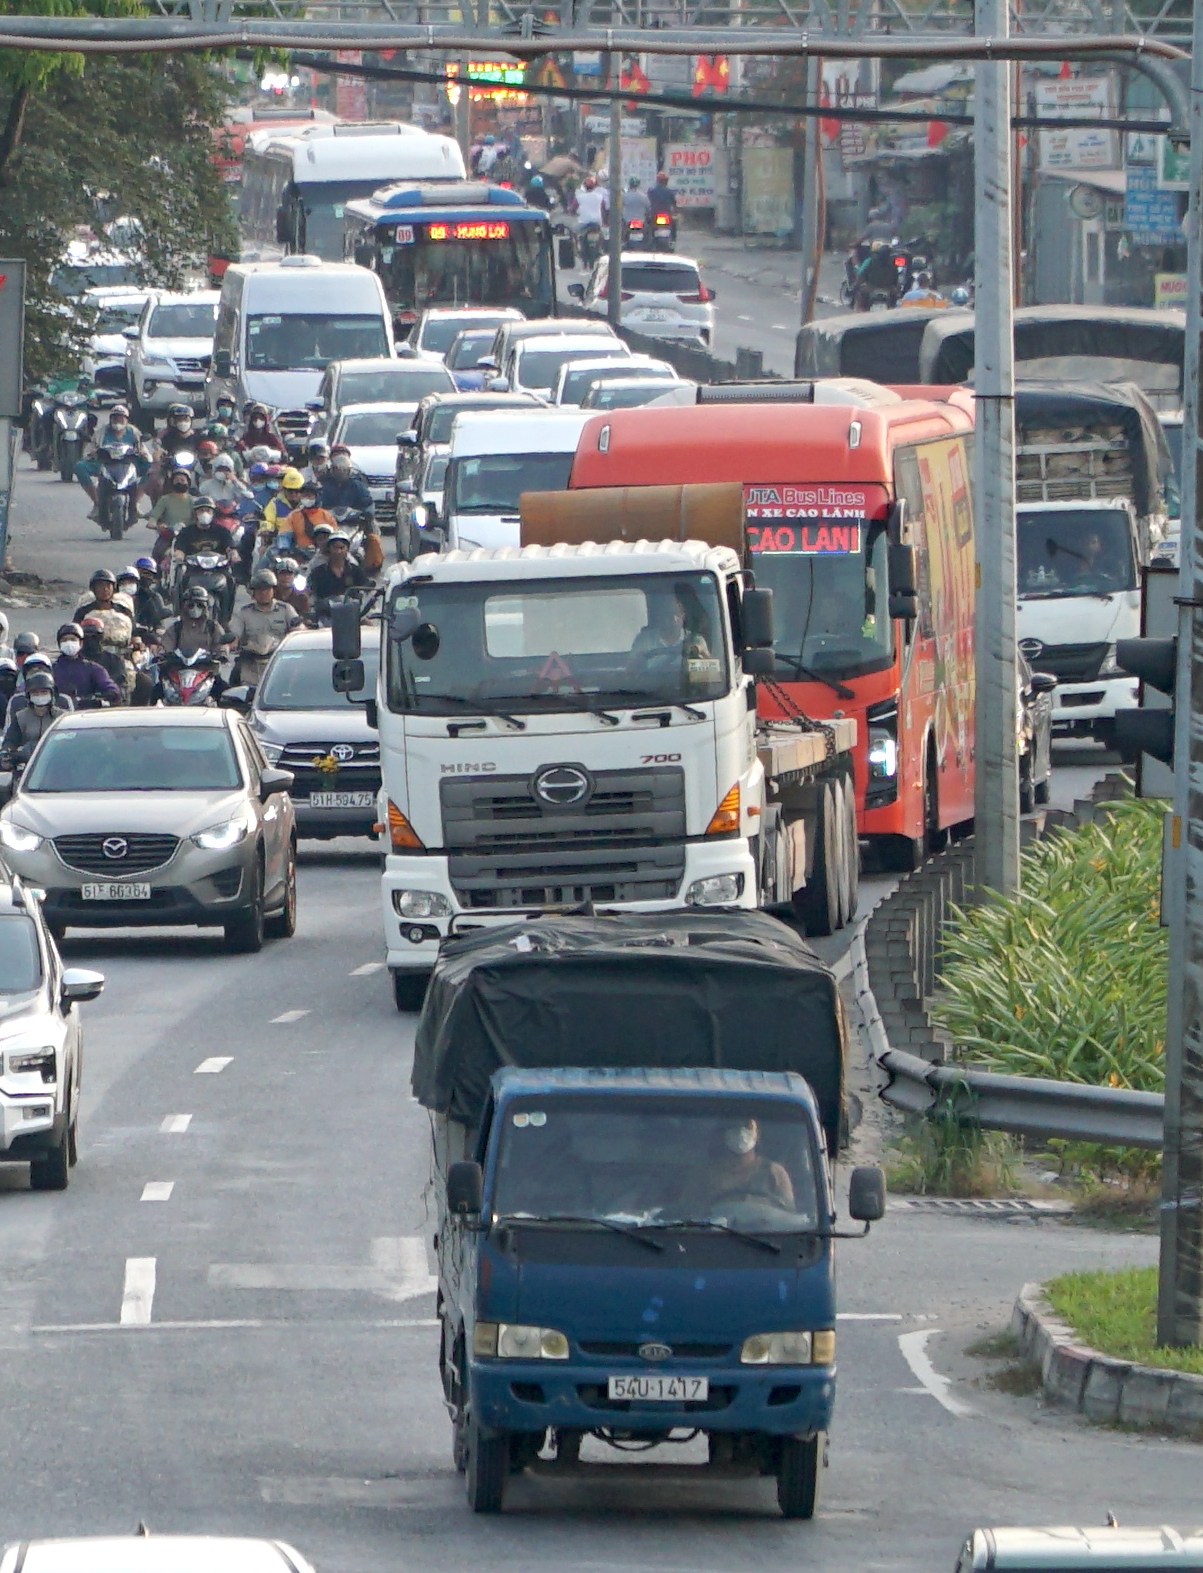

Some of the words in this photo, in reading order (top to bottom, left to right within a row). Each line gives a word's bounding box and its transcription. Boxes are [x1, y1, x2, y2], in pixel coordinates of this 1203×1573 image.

[783, 488, 816, 505] Bus
[817, 488, 865, 506] Lines
[761, 508, 784, 518] XE
[785, 508, 819, 518] CAO
[639, 753, 682, 765] 700
[440, 761, 497, 774] HINO
